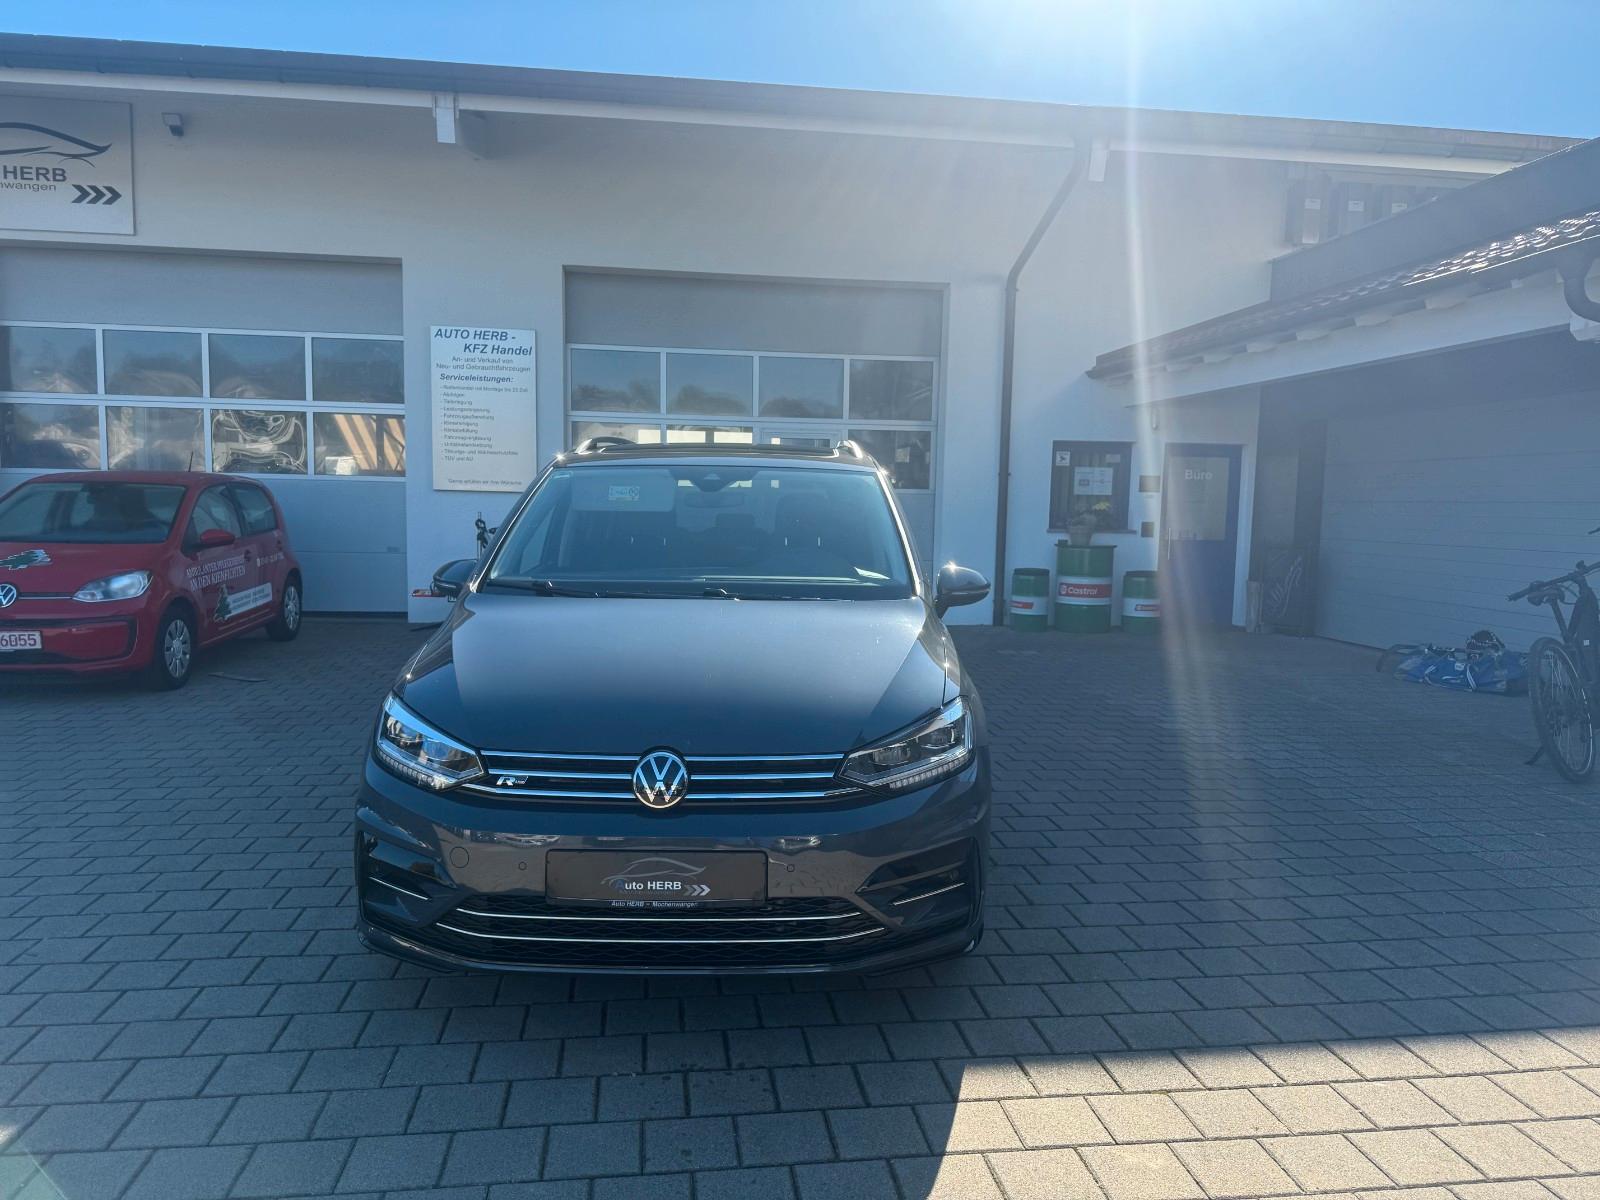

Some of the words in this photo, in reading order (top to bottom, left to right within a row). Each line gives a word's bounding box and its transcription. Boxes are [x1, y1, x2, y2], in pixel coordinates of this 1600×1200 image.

[2, 164, 67, 182] HERB
[434, 328, 470, 340] AUTO
[473, 330, 508, 341] HERB
[463, 343, 489, 354] KFZ
[491, 344, 533, 356] Handel
[439, 372, 515, 384] Serviceleistungen:
[1067, 586, 1098, 595] Castrol
[614, 879, 644, 890] Auto
[647, 881, 682, 890] HERB
